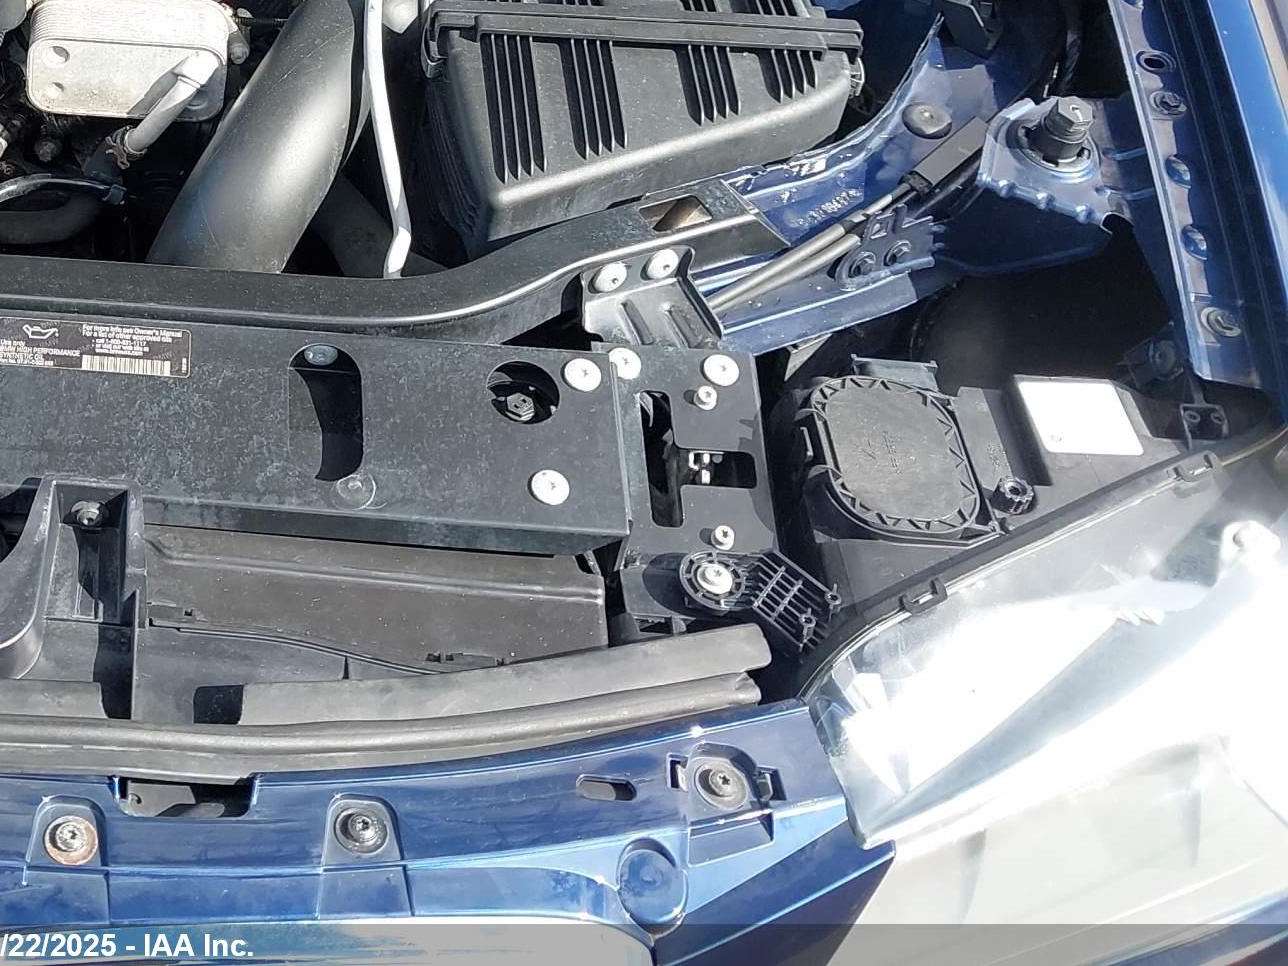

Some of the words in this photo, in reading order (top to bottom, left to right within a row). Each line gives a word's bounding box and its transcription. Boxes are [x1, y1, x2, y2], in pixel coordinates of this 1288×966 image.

[134, 328, 160, 336] Owner's
[0, 352, 34, 360] SYNTHETIC
[33, 347, 81, 357] PERFORMANCE
